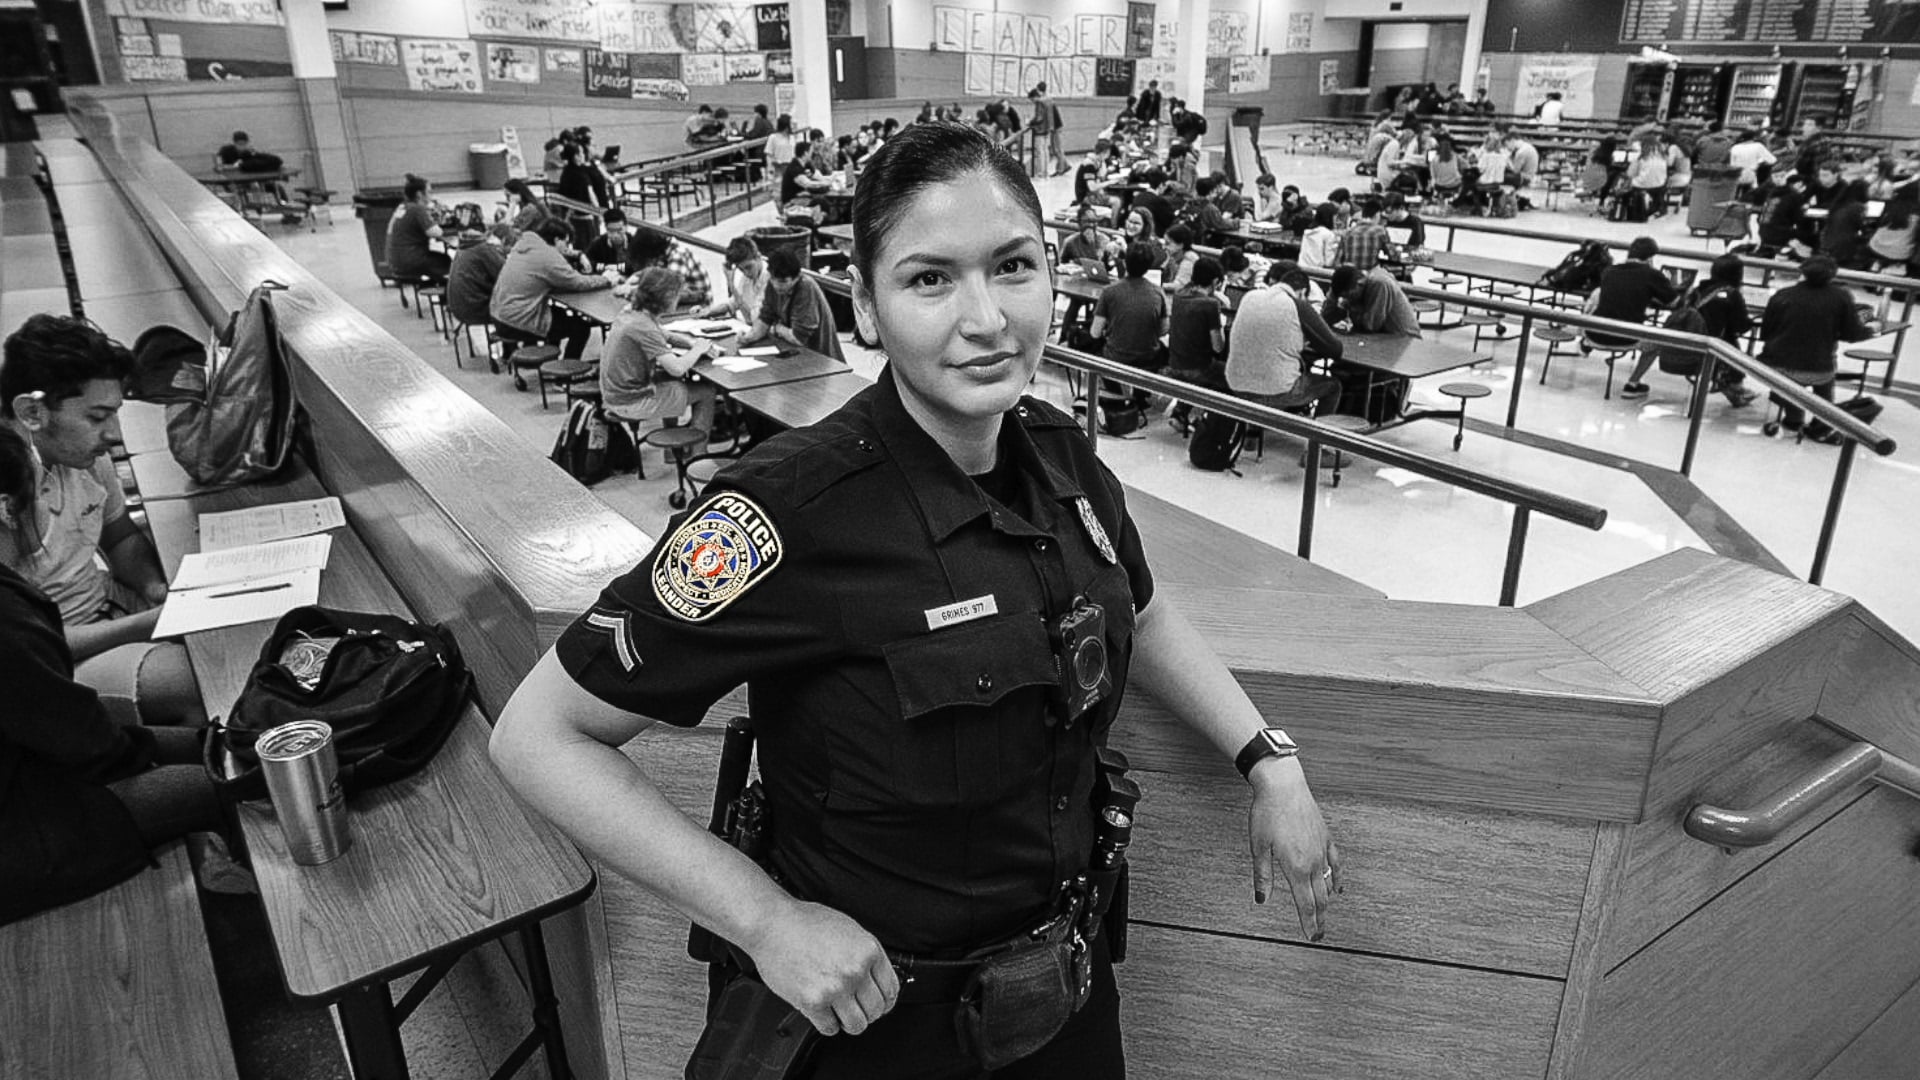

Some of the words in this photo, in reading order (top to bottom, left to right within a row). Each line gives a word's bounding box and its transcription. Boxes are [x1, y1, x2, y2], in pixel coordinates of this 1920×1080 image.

[942, 10, 1121, 55] LEANDER
[967, 58, 1091, 95] LIONS
[713, 497, 777, 562] POLICE
[655, 568, 701, 618] LEANDER
[941, 606, 970, 621] GRIMES
